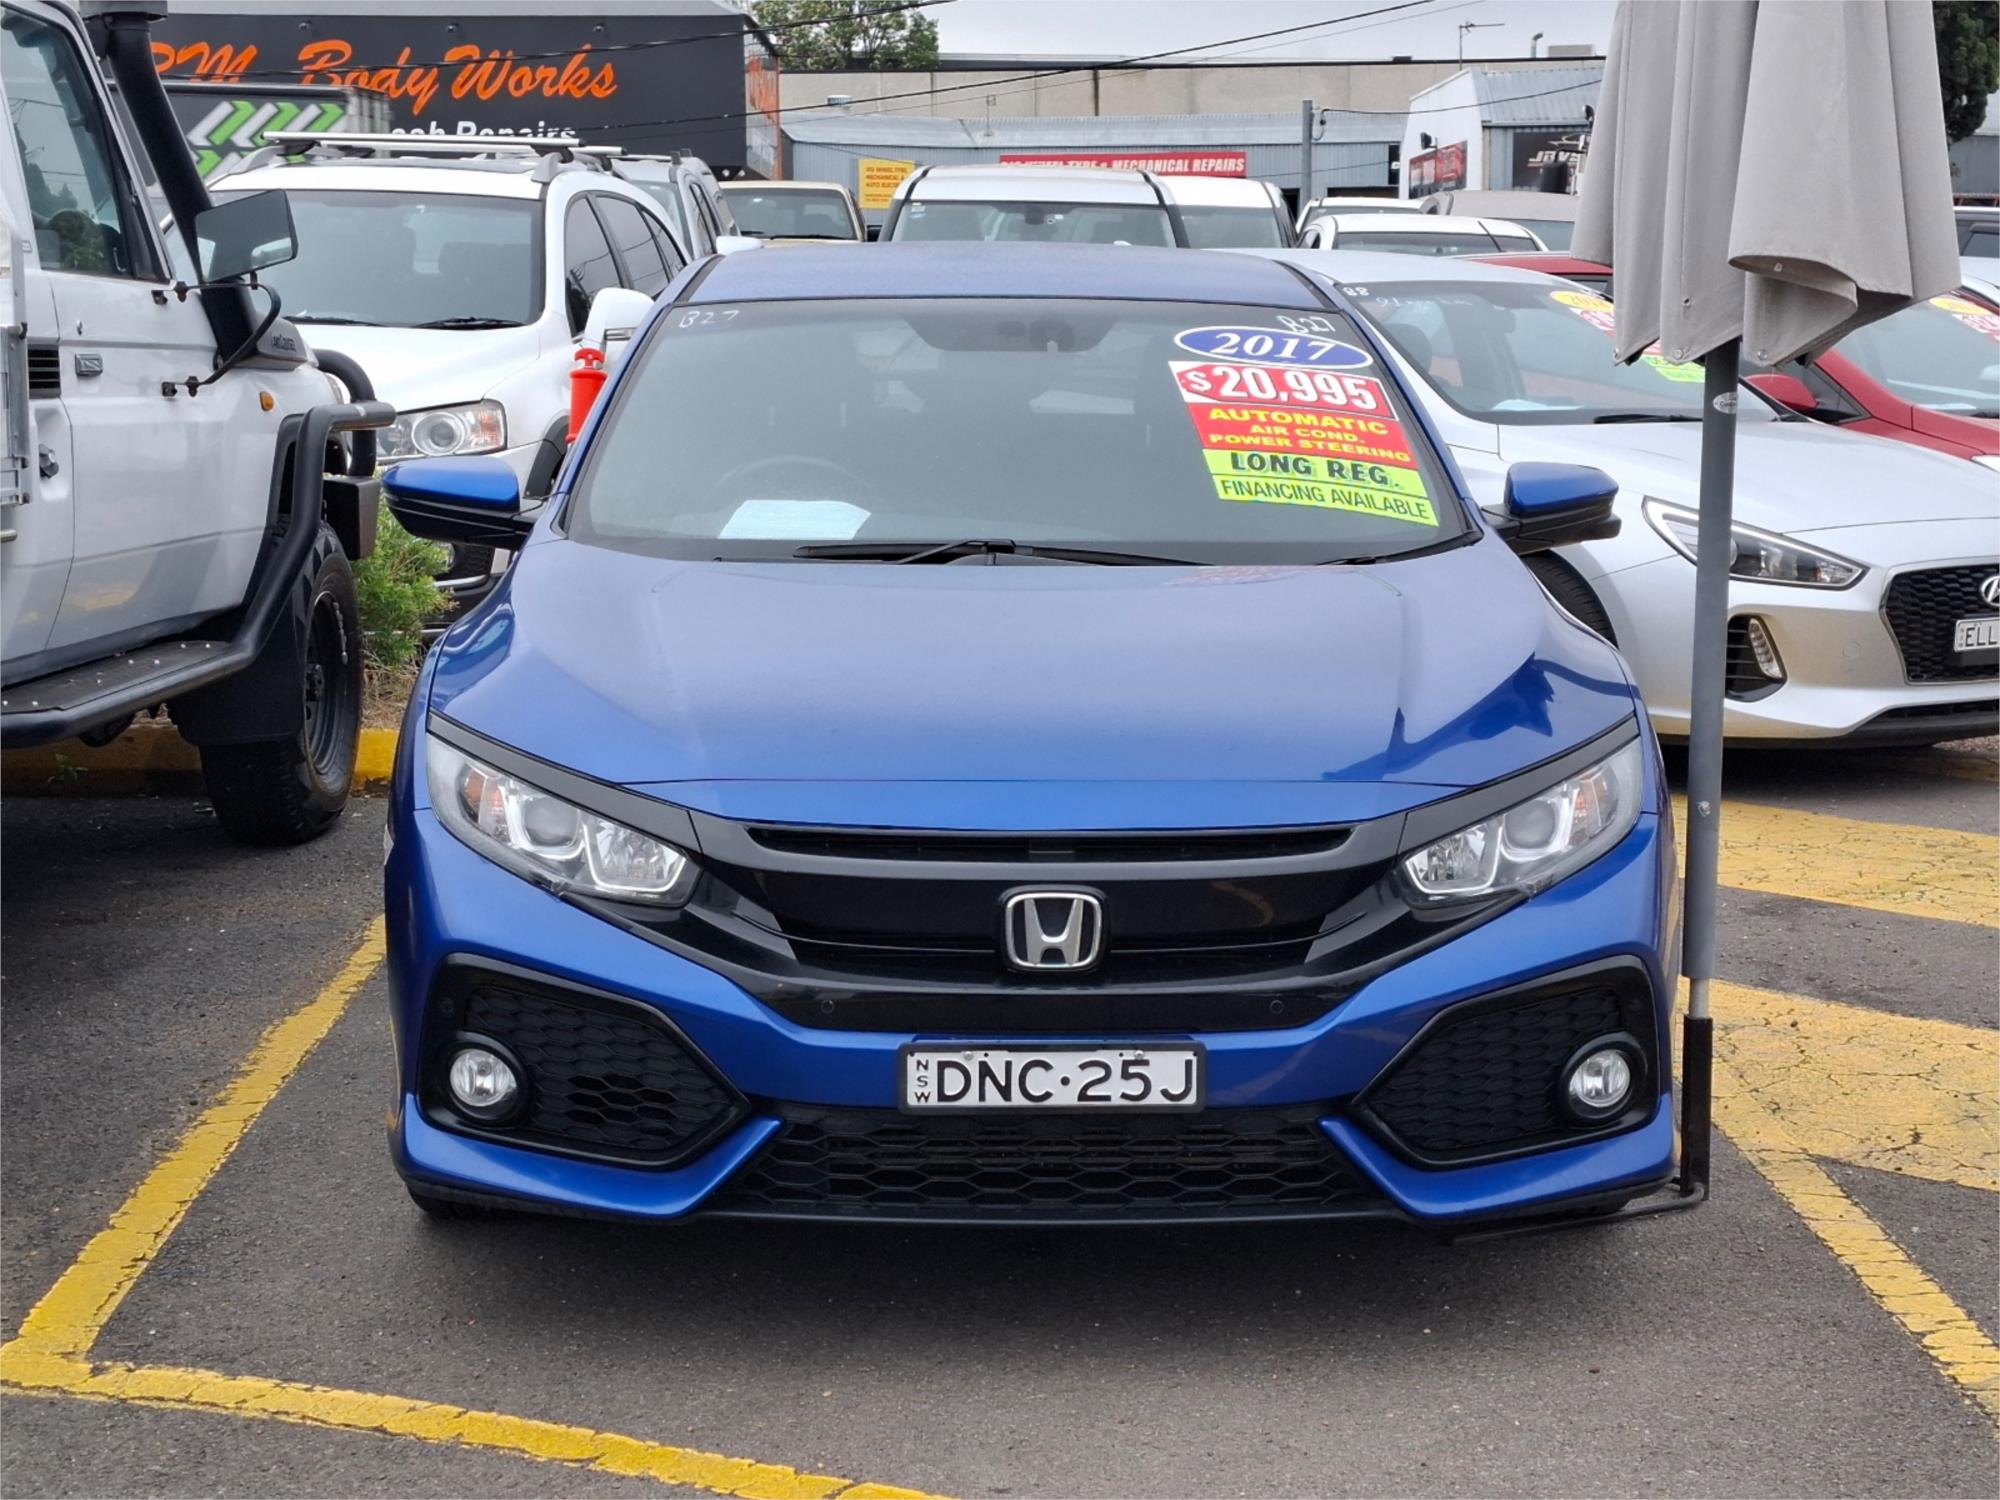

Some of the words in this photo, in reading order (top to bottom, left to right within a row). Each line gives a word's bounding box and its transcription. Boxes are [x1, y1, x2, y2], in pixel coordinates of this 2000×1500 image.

[298, 38, 440, 115] Body
[444, 42, 618, 99] Works
[1112, 159, 1190, 173] MECHANICAL
[1192, 158, 1245, 173] REPAIRS
[1210, 331, 1337, 361] 2017
[1185, 366, 1378, 410] $20,995
[1209, 407, 1389, 435] AUTOMATIC
[1250, 424, 1291, 436] AIR
[1295, 427, 1367, 444] COND.
[1209, 433, 1294, 448] POWER
[1298, 438, 1411, 463] STEERING
[1230, 452, 1314, 475] LONG
[1326, 458, 1404, 487] REG.
[1221, 479, 1326, 503] FINANCING
[1331, 489, 1430, 520] AVAILABLE
[1965, 626, 1999, 648] ELL
